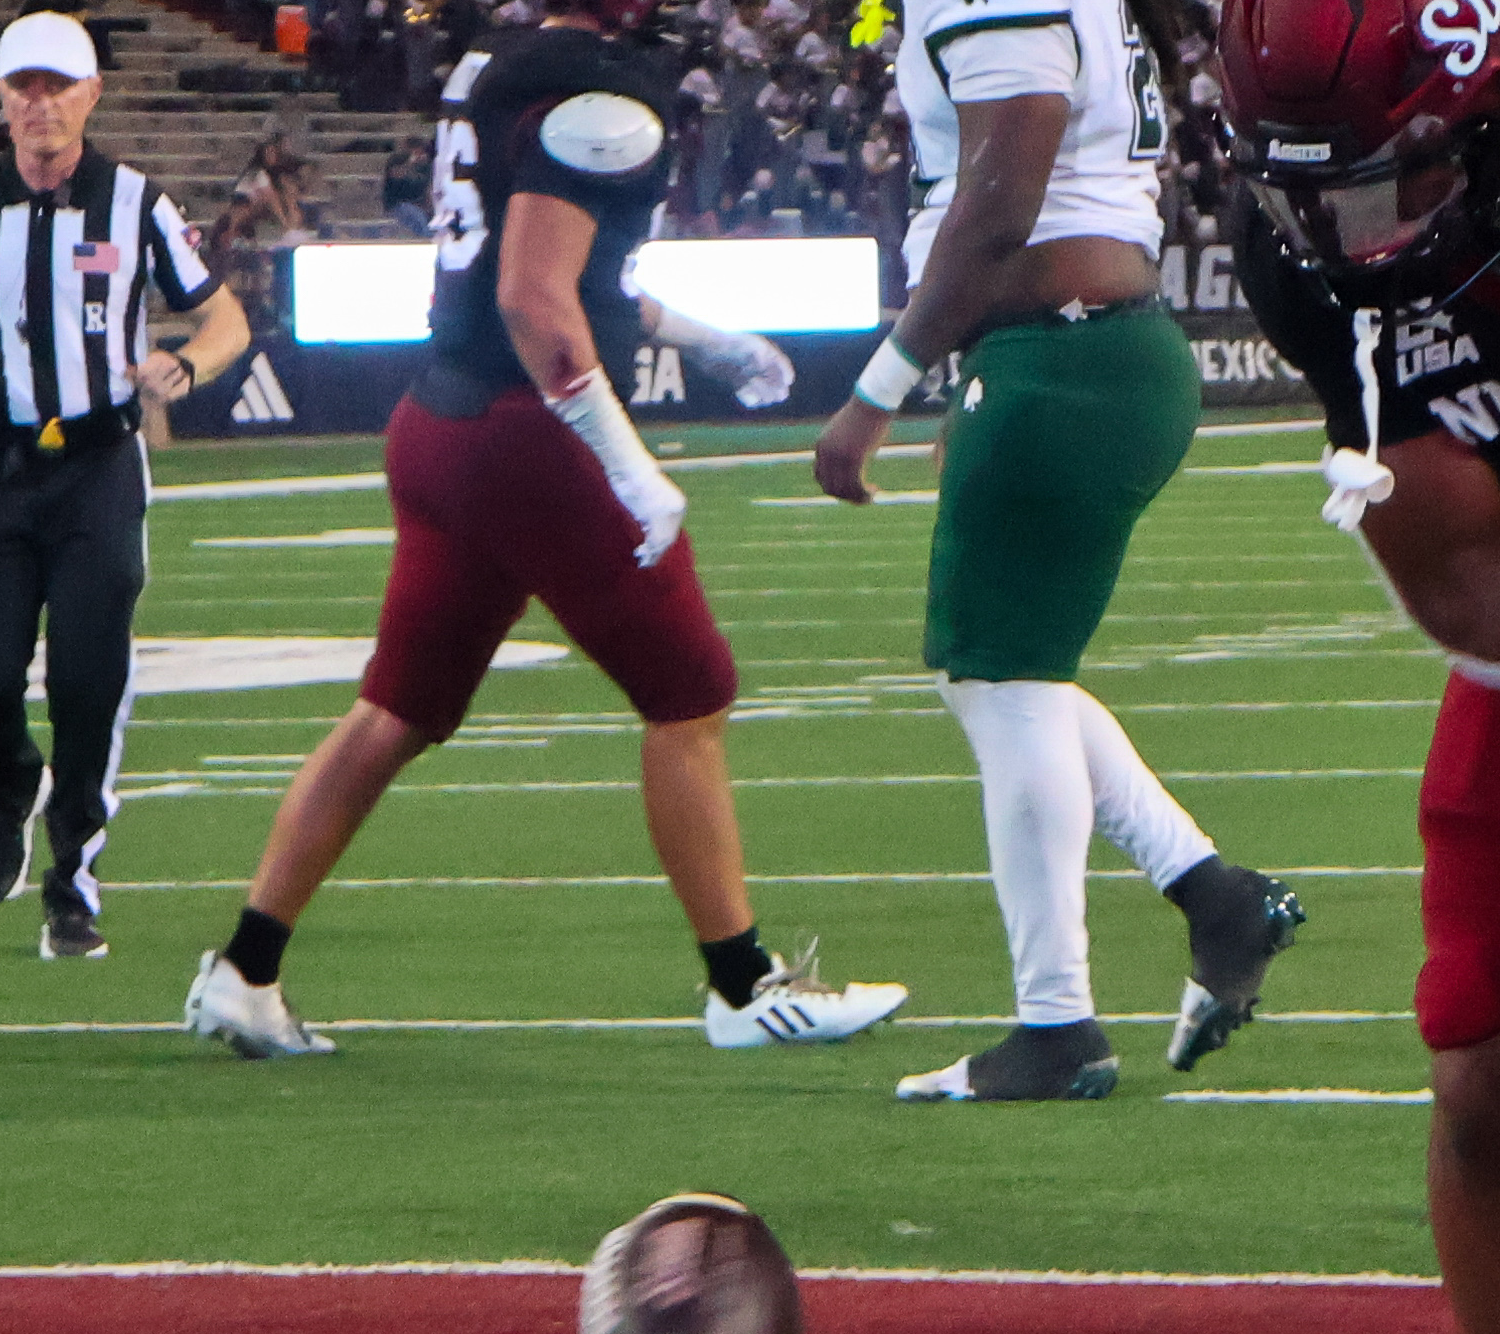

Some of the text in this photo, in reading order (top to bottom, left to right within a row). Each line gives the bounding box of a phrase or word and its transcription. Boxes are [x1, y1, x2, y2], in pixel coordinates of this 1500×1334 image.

[1160, 243, 1251, 310] AG
[1188, 339, 1304, 382] EXIC
[1396, 334, 1481, 387] USA
